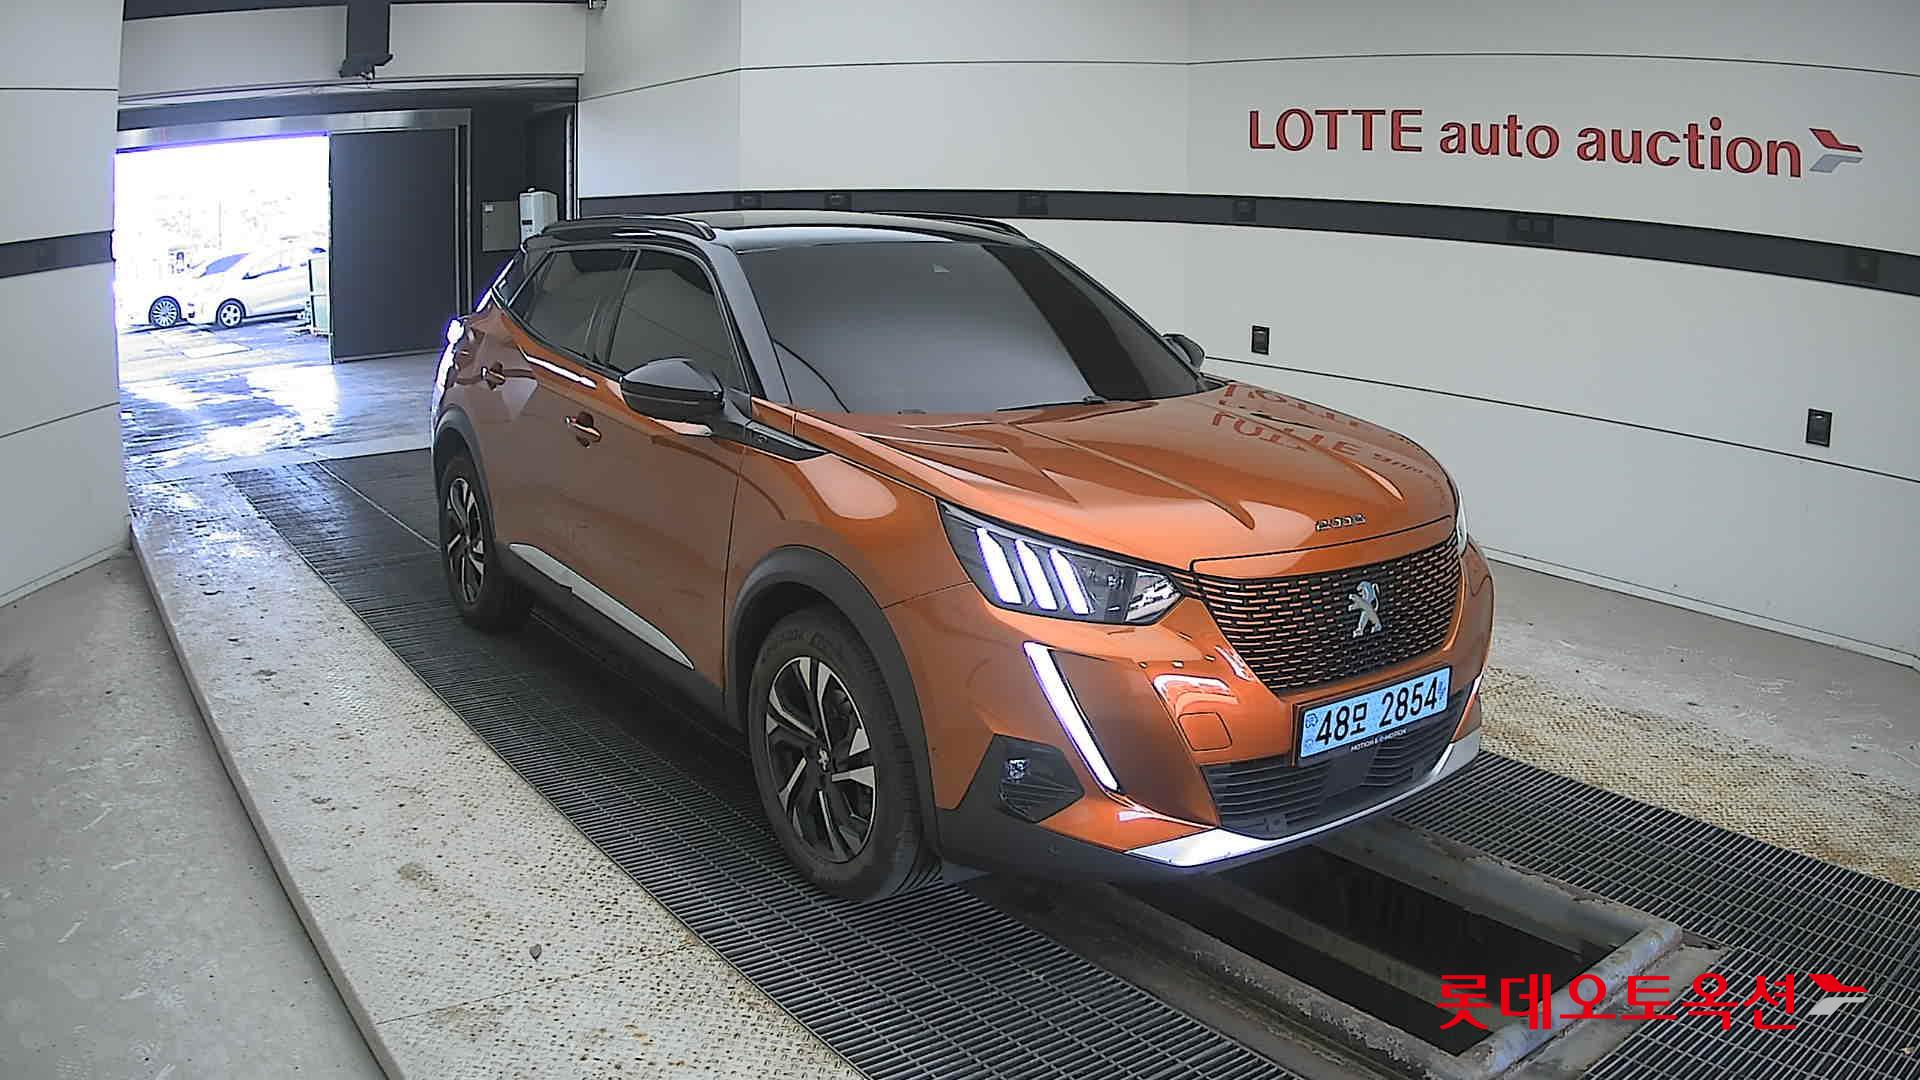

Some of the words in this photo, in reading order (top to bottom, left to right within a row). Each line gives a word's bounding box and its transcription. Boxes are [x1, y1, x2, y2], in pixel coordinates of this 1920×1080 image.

[1248, 109, 1424, 152] LOTTE
[1439, 114, 1560, 160] auto
[1576, 117, 1803, 178] auction
[1315, 702, 1368, 745] 48모
[1379, 676, 1438, 727] 2854
